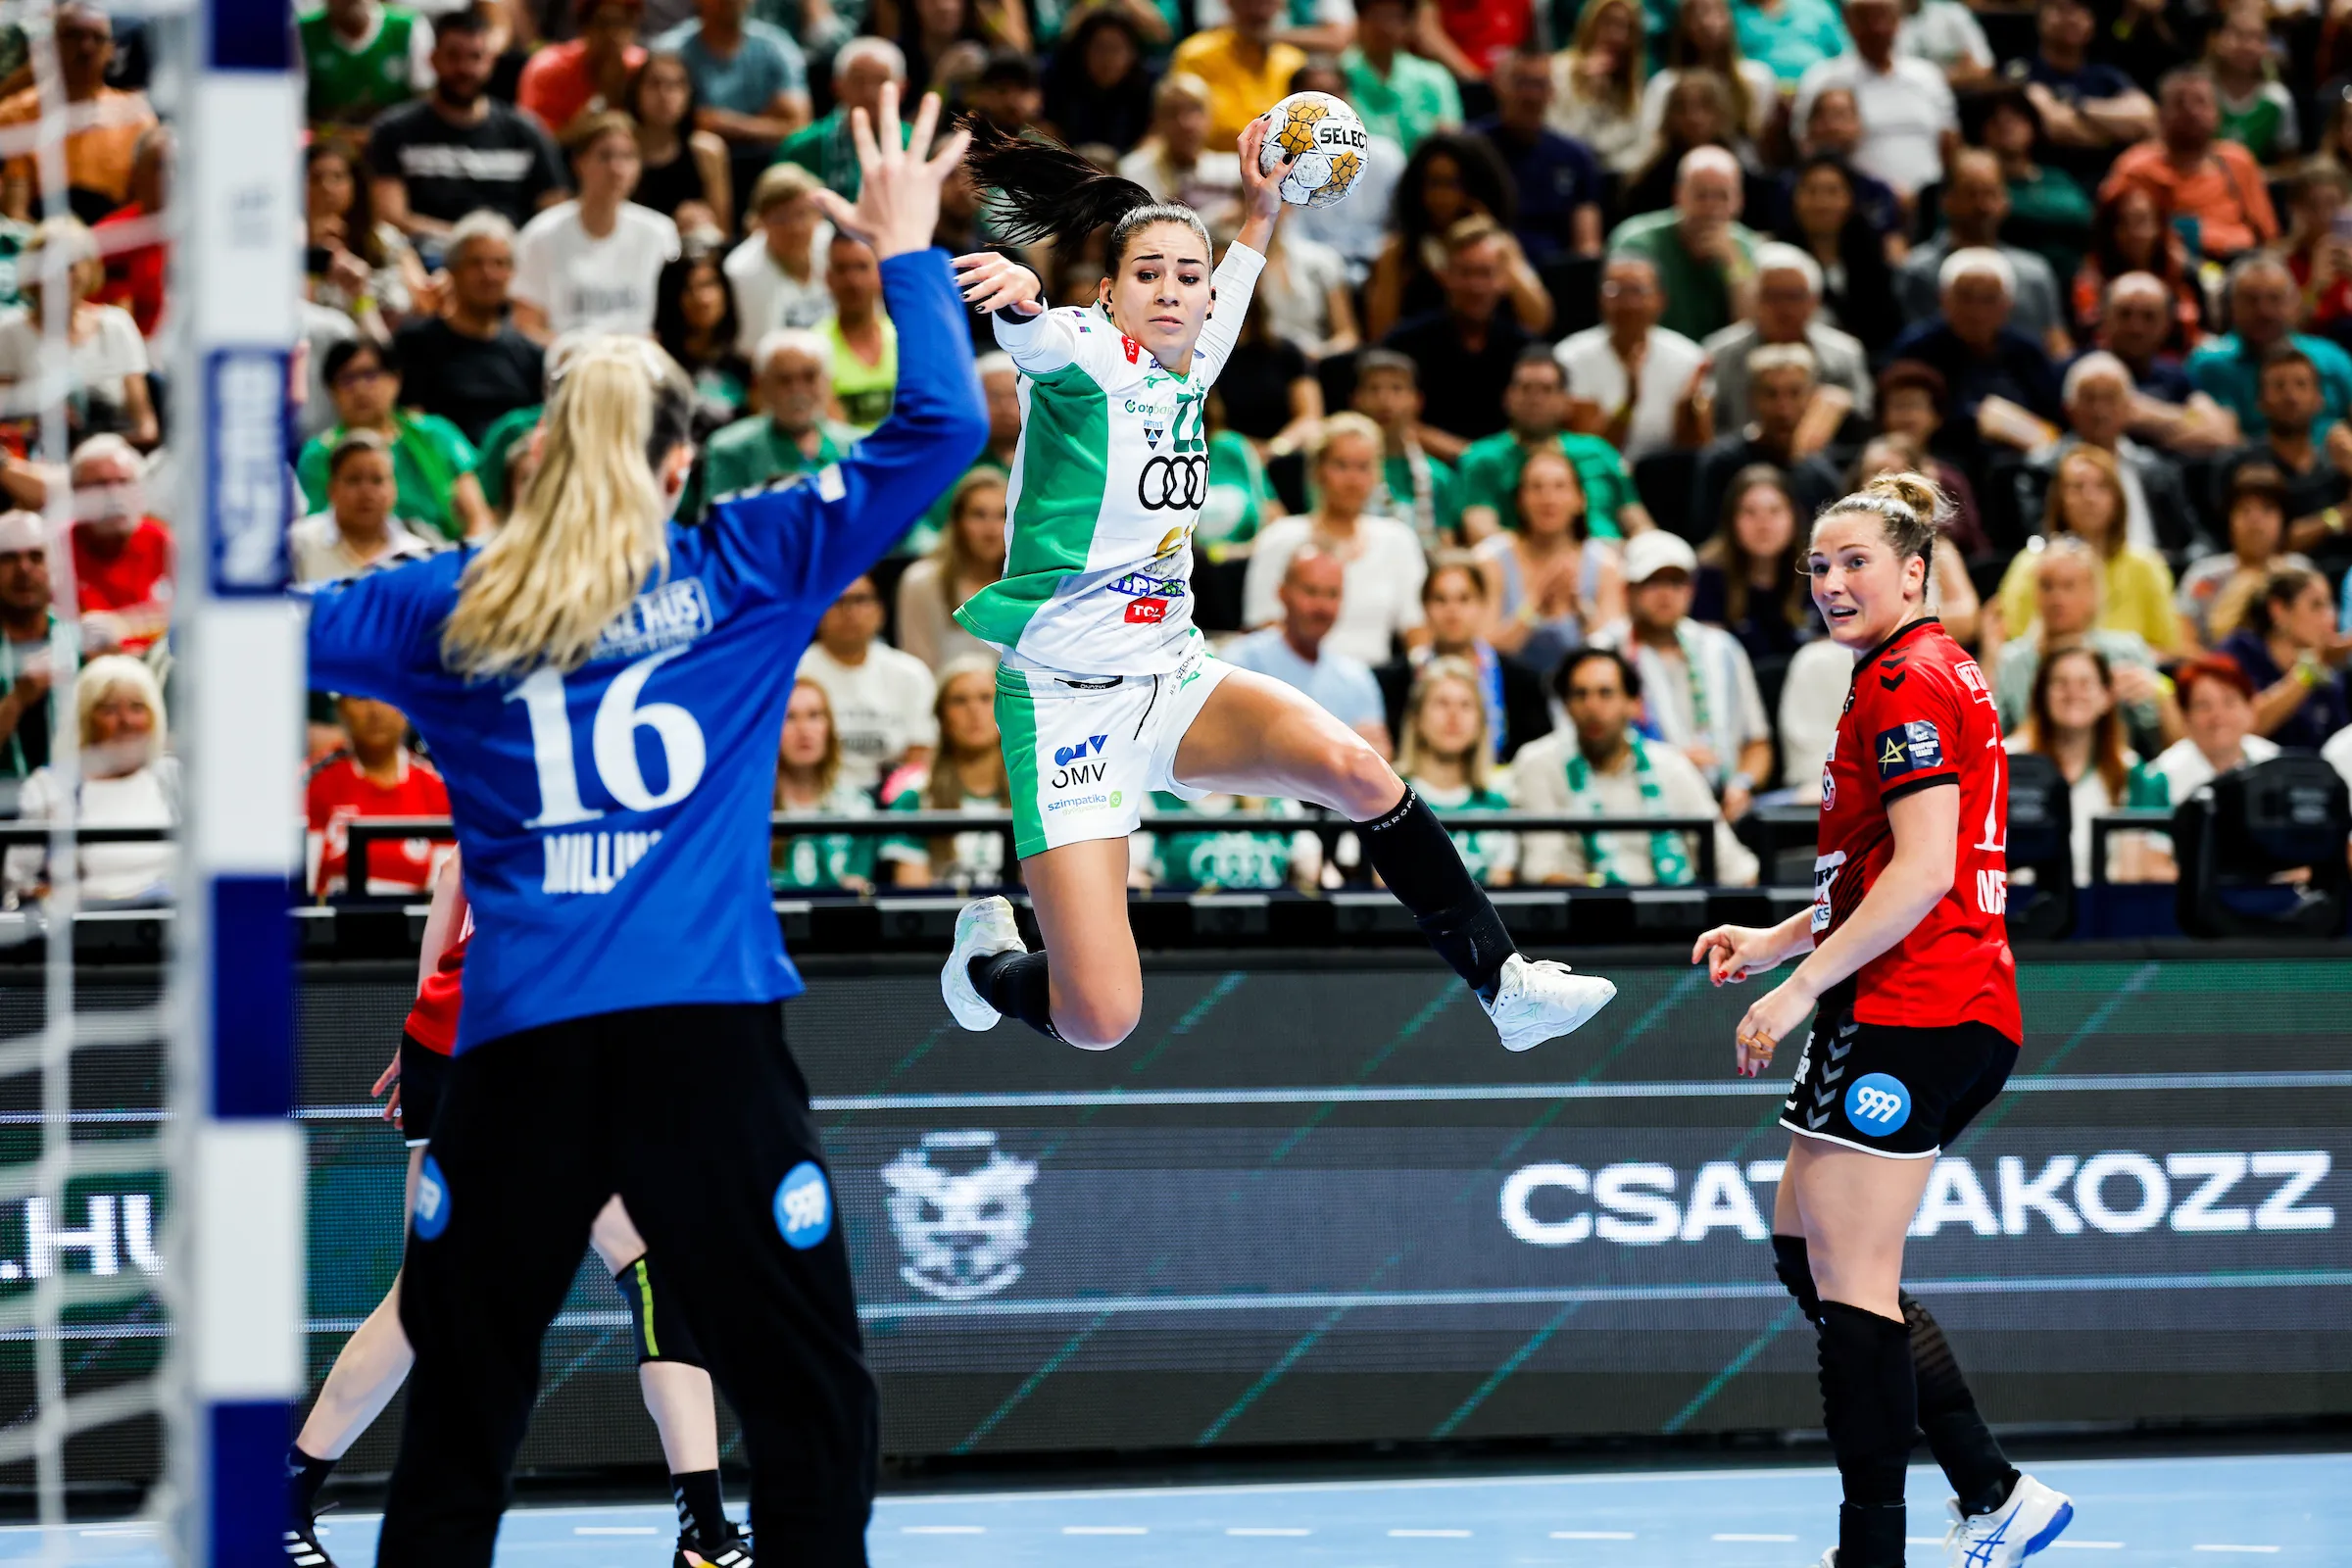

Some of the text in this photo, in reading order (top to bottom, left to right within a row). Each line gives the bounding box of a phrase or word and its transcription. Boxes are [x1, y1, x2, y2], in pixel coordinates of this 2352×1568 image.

[1133, 605, 1160, 617] TCL
[502, 643, 708, 829] 16
[1052, 762, 1106, 789] OMV
[1048, 794, 1106, 811] szimpatika
[1372, 781, 1416, 831] ZEROPO
[1853, 1085, 1902, 1124] 999
[1499, 1150, 2335, 1246] CSAAKOZZ
